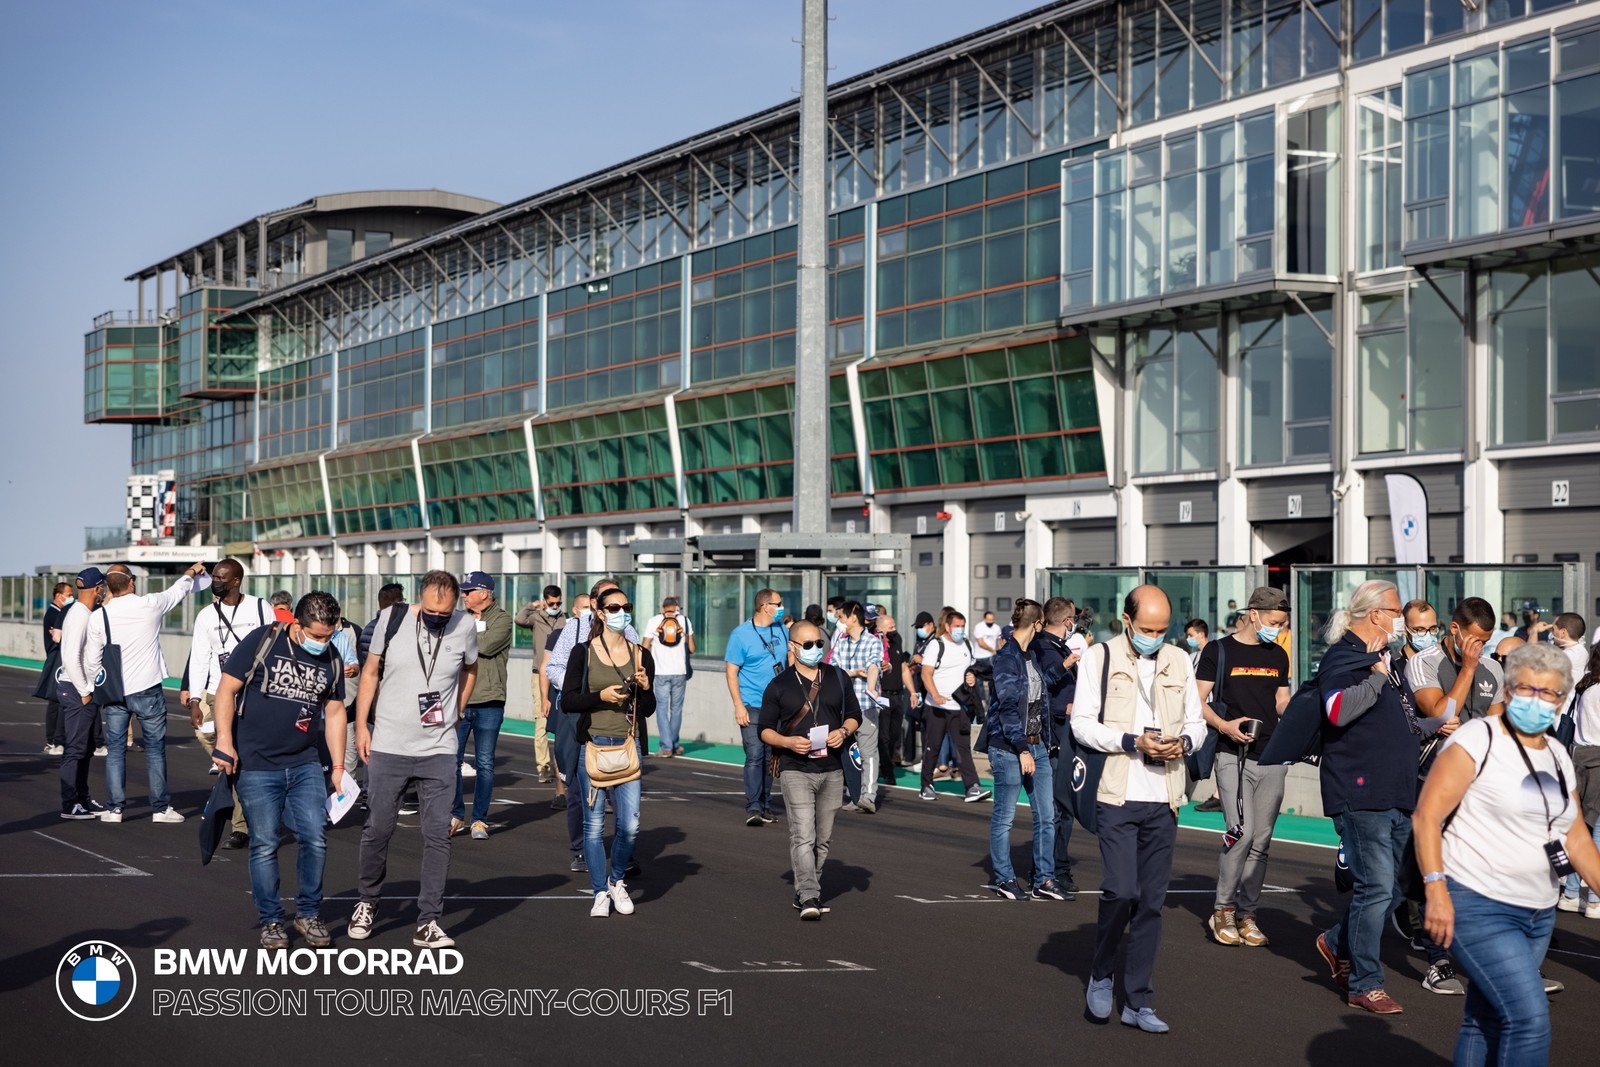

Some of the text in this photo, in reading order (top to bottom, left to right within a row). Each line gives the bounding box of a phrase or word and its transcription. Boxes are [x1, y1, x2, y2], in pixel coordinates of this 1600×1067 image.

[1554, 484, 1568, 503] 22
[1072, 499, 1082, 517] 18
[1181, 503, 1191, 520] 19
[1290, 498, 1301, 515] 20
[316, 670, 328, 685] &
